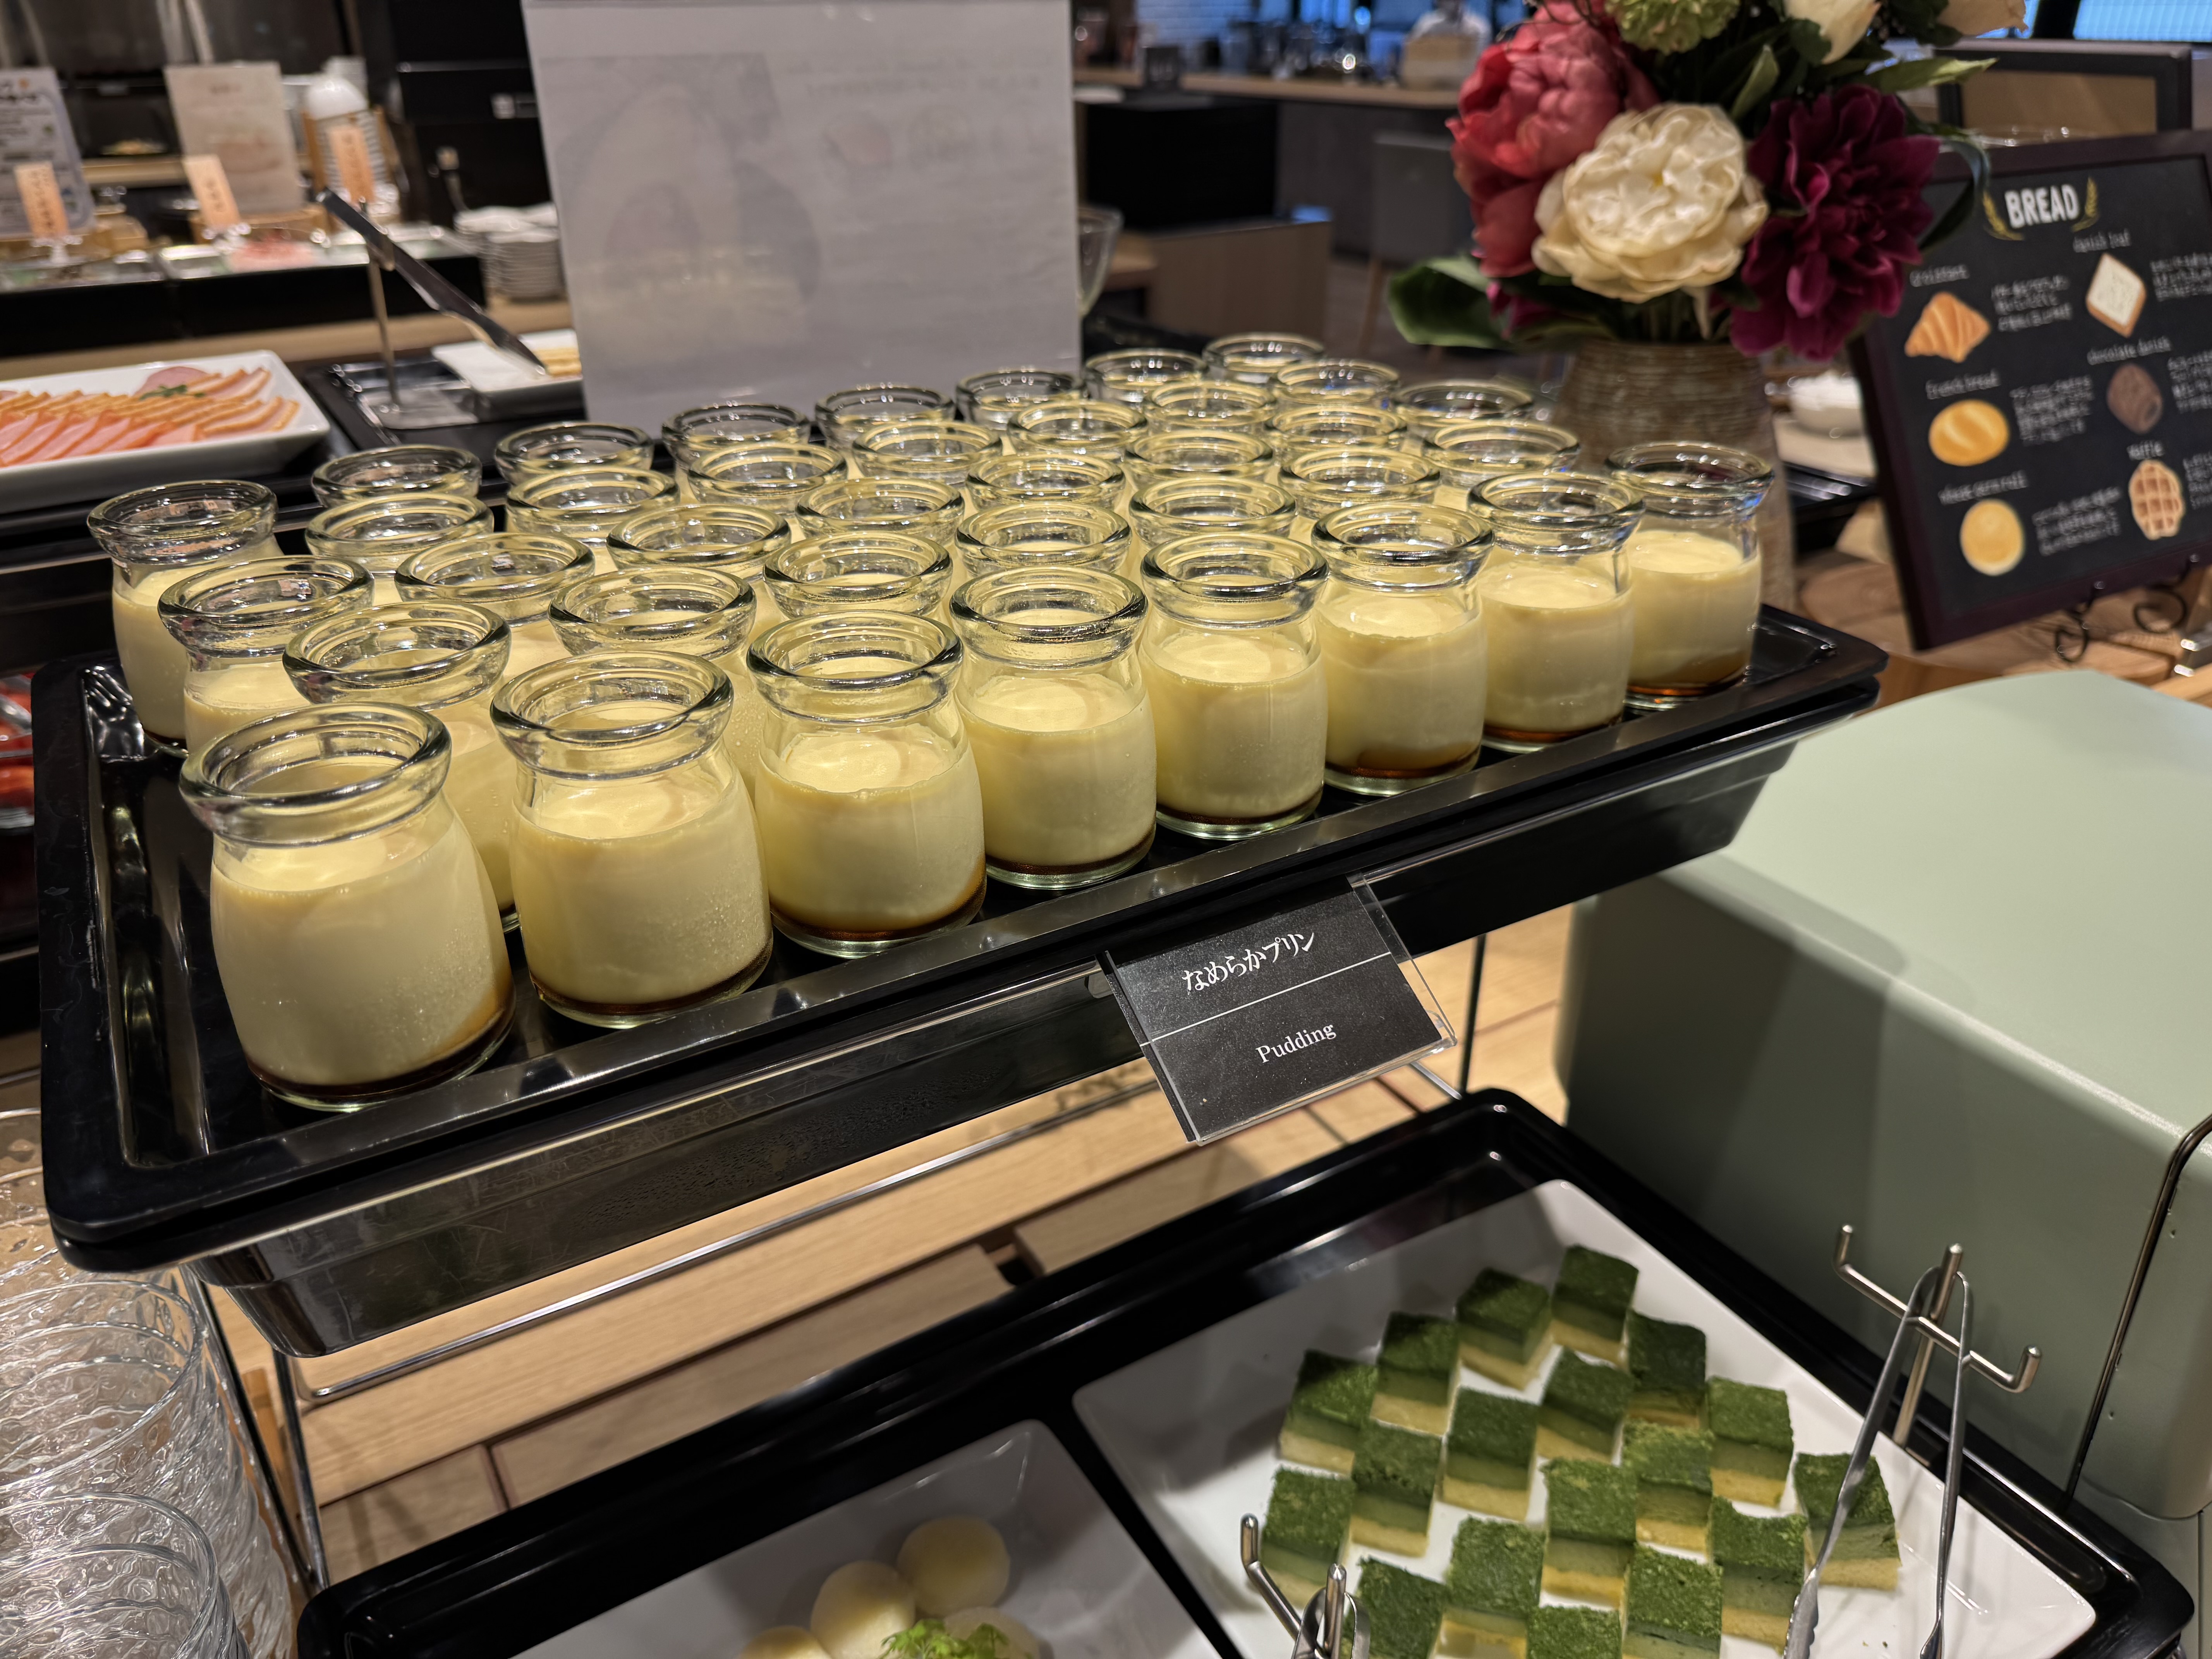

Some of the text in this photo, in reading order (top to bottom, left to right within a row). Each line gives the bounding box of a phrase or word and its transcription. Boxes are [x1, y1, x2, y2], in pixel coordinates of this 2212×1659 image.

[2004, 184, 2081, 228] BREAD
[1182, 932, 1314, 991] なめらかプリン
[1255, 1024, 1336, 1063] Pudding
